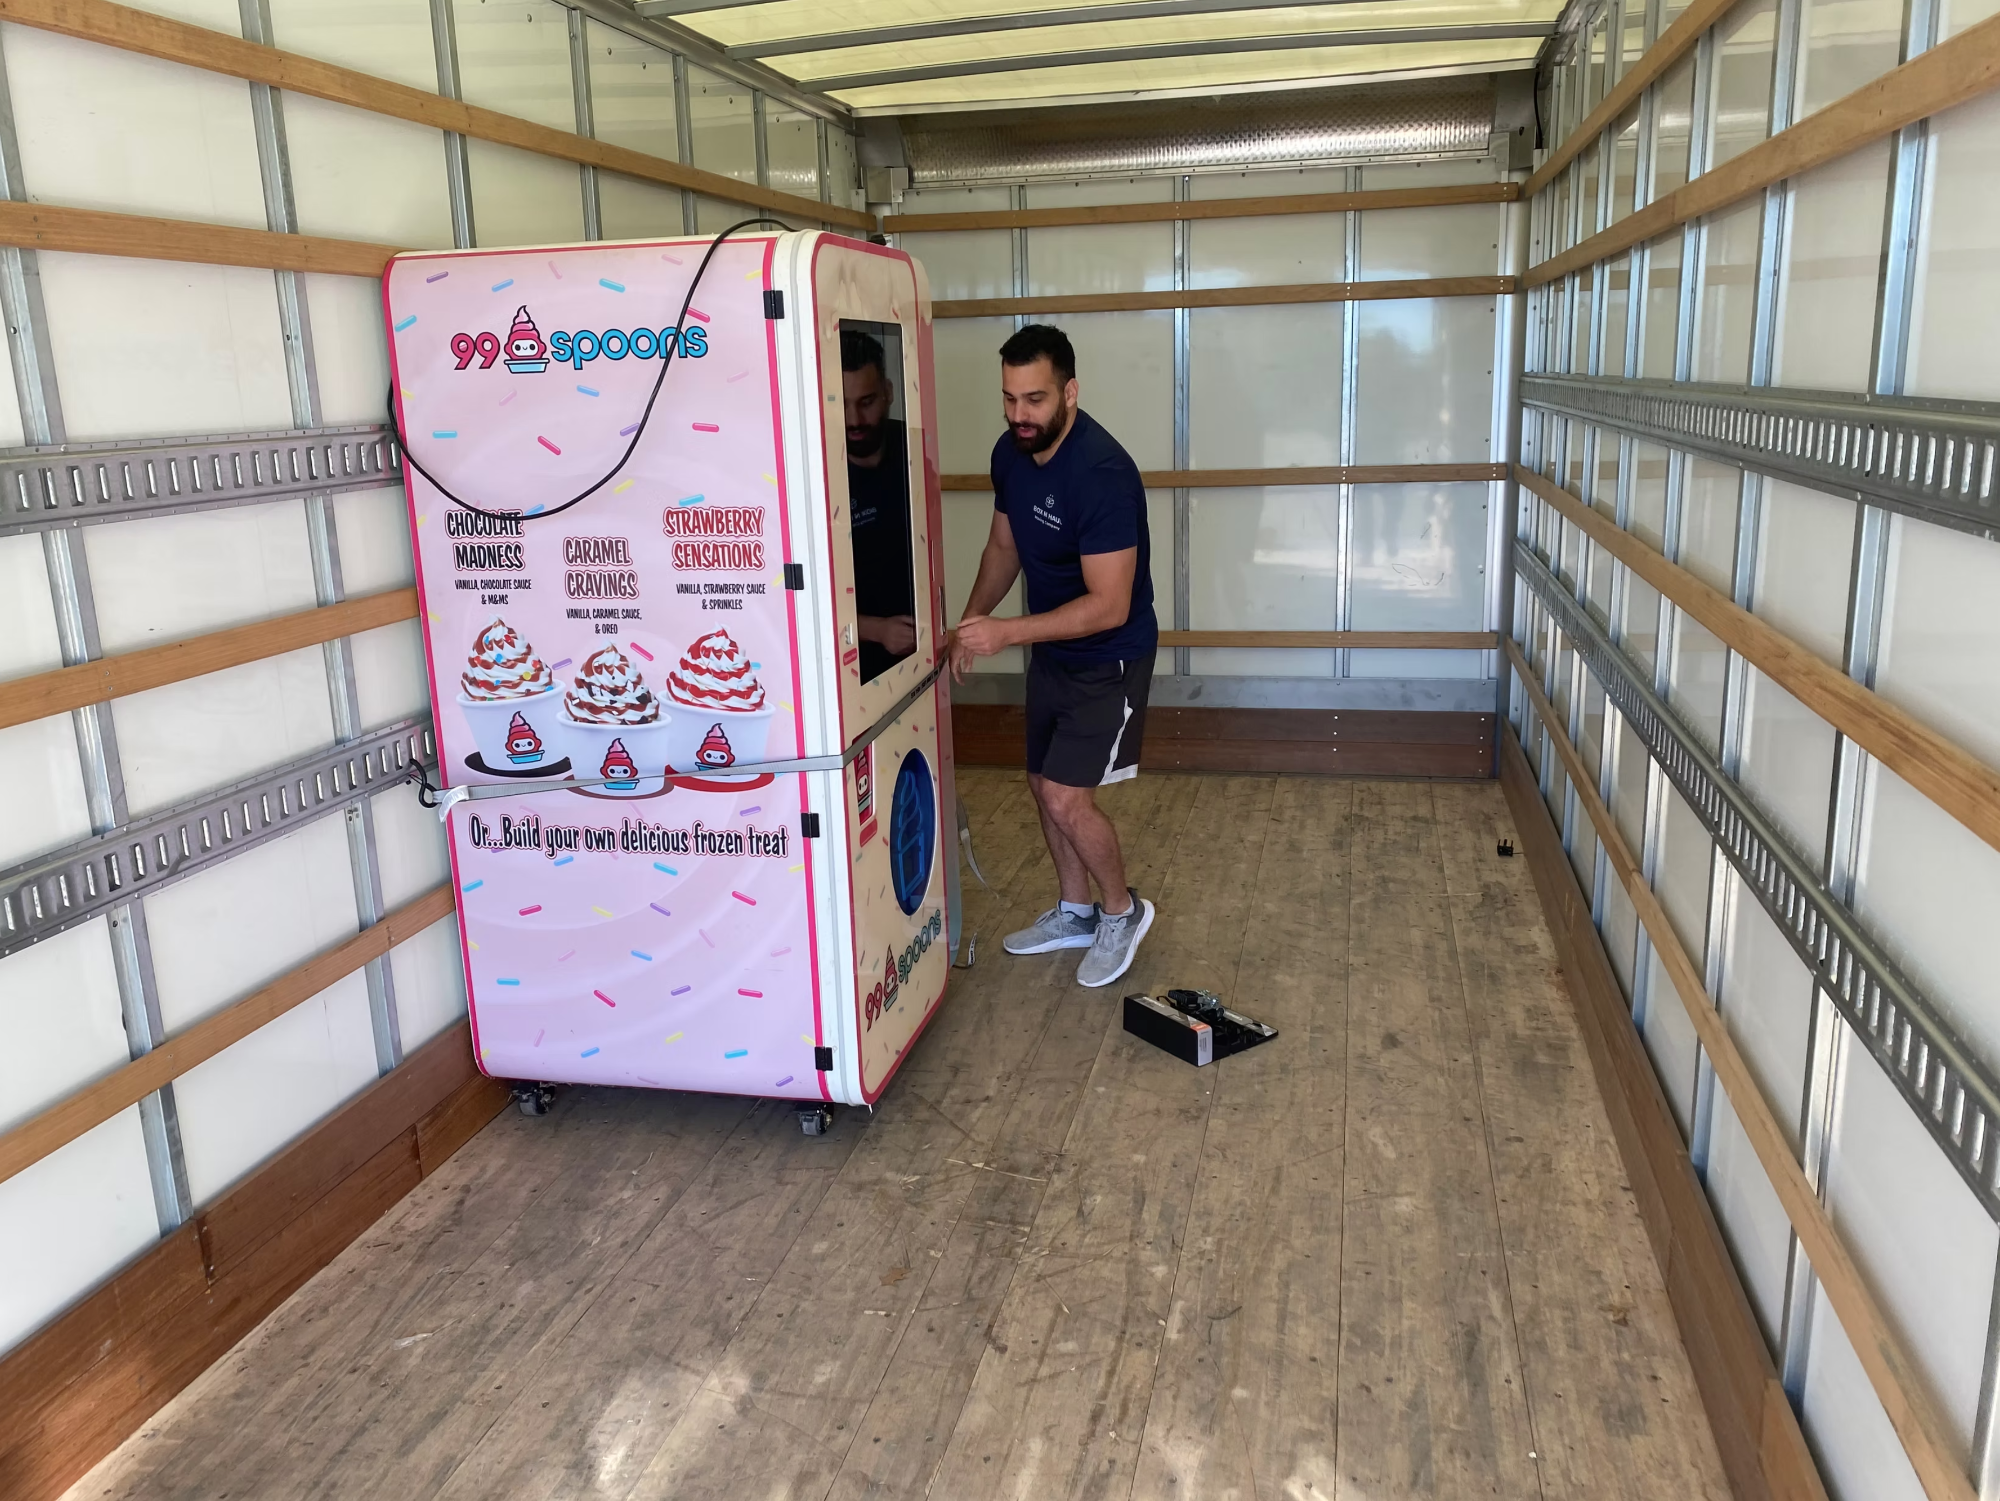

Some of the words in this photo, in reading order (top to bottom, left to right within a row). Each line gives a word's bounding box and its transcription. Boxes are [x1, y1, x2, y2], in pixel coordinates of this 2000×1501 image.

[451, 332, 501, 370] 99
[550, 326, 708, 370] spoons
[445, 510, 524, 538] CHOCOLATE
[664, 507, 764, 536] STRAWBERRY
[454, 543, 524, 570] MADNESS
[564, 538, 632, 565] CARAMEL
[673, 541, 764, 570] SENSATIONS
[455, 579, 479, 590] VANILLA,
[480, 579, 512, 590] CHOCOLATE
[513, 579, 532, 590] SAUCE
[566, 570, 638, 598] CRAVINGS
[676, 583, 702, 595] VANILLA,
[703, 583, 744, 595] STRAWBERRY
[746, 583, 766, 595] SAUCE
[481, 594, 487, 605] &
[488, 594, 509, 605] M&MS
[702, 599, 708, 610] &
[709, 599, 743, 610] SPRINKLES
[566, 608, 592, 620] VANILLA,
[592, 608, 620, 619] CARAMEL
[595, 623, 601, 634] &
[602, 623, 618, 634] OREO
[544, 826, 580, 859] your
[584, 827, 617, 852] own
[620, 818, 689, 854] delicious
[692, 821, 745, 856] frozen
[746, 824, 789, 858] treat
[865, 982, 883, 1033] 99
[898, 909, 941, 985] spoons
